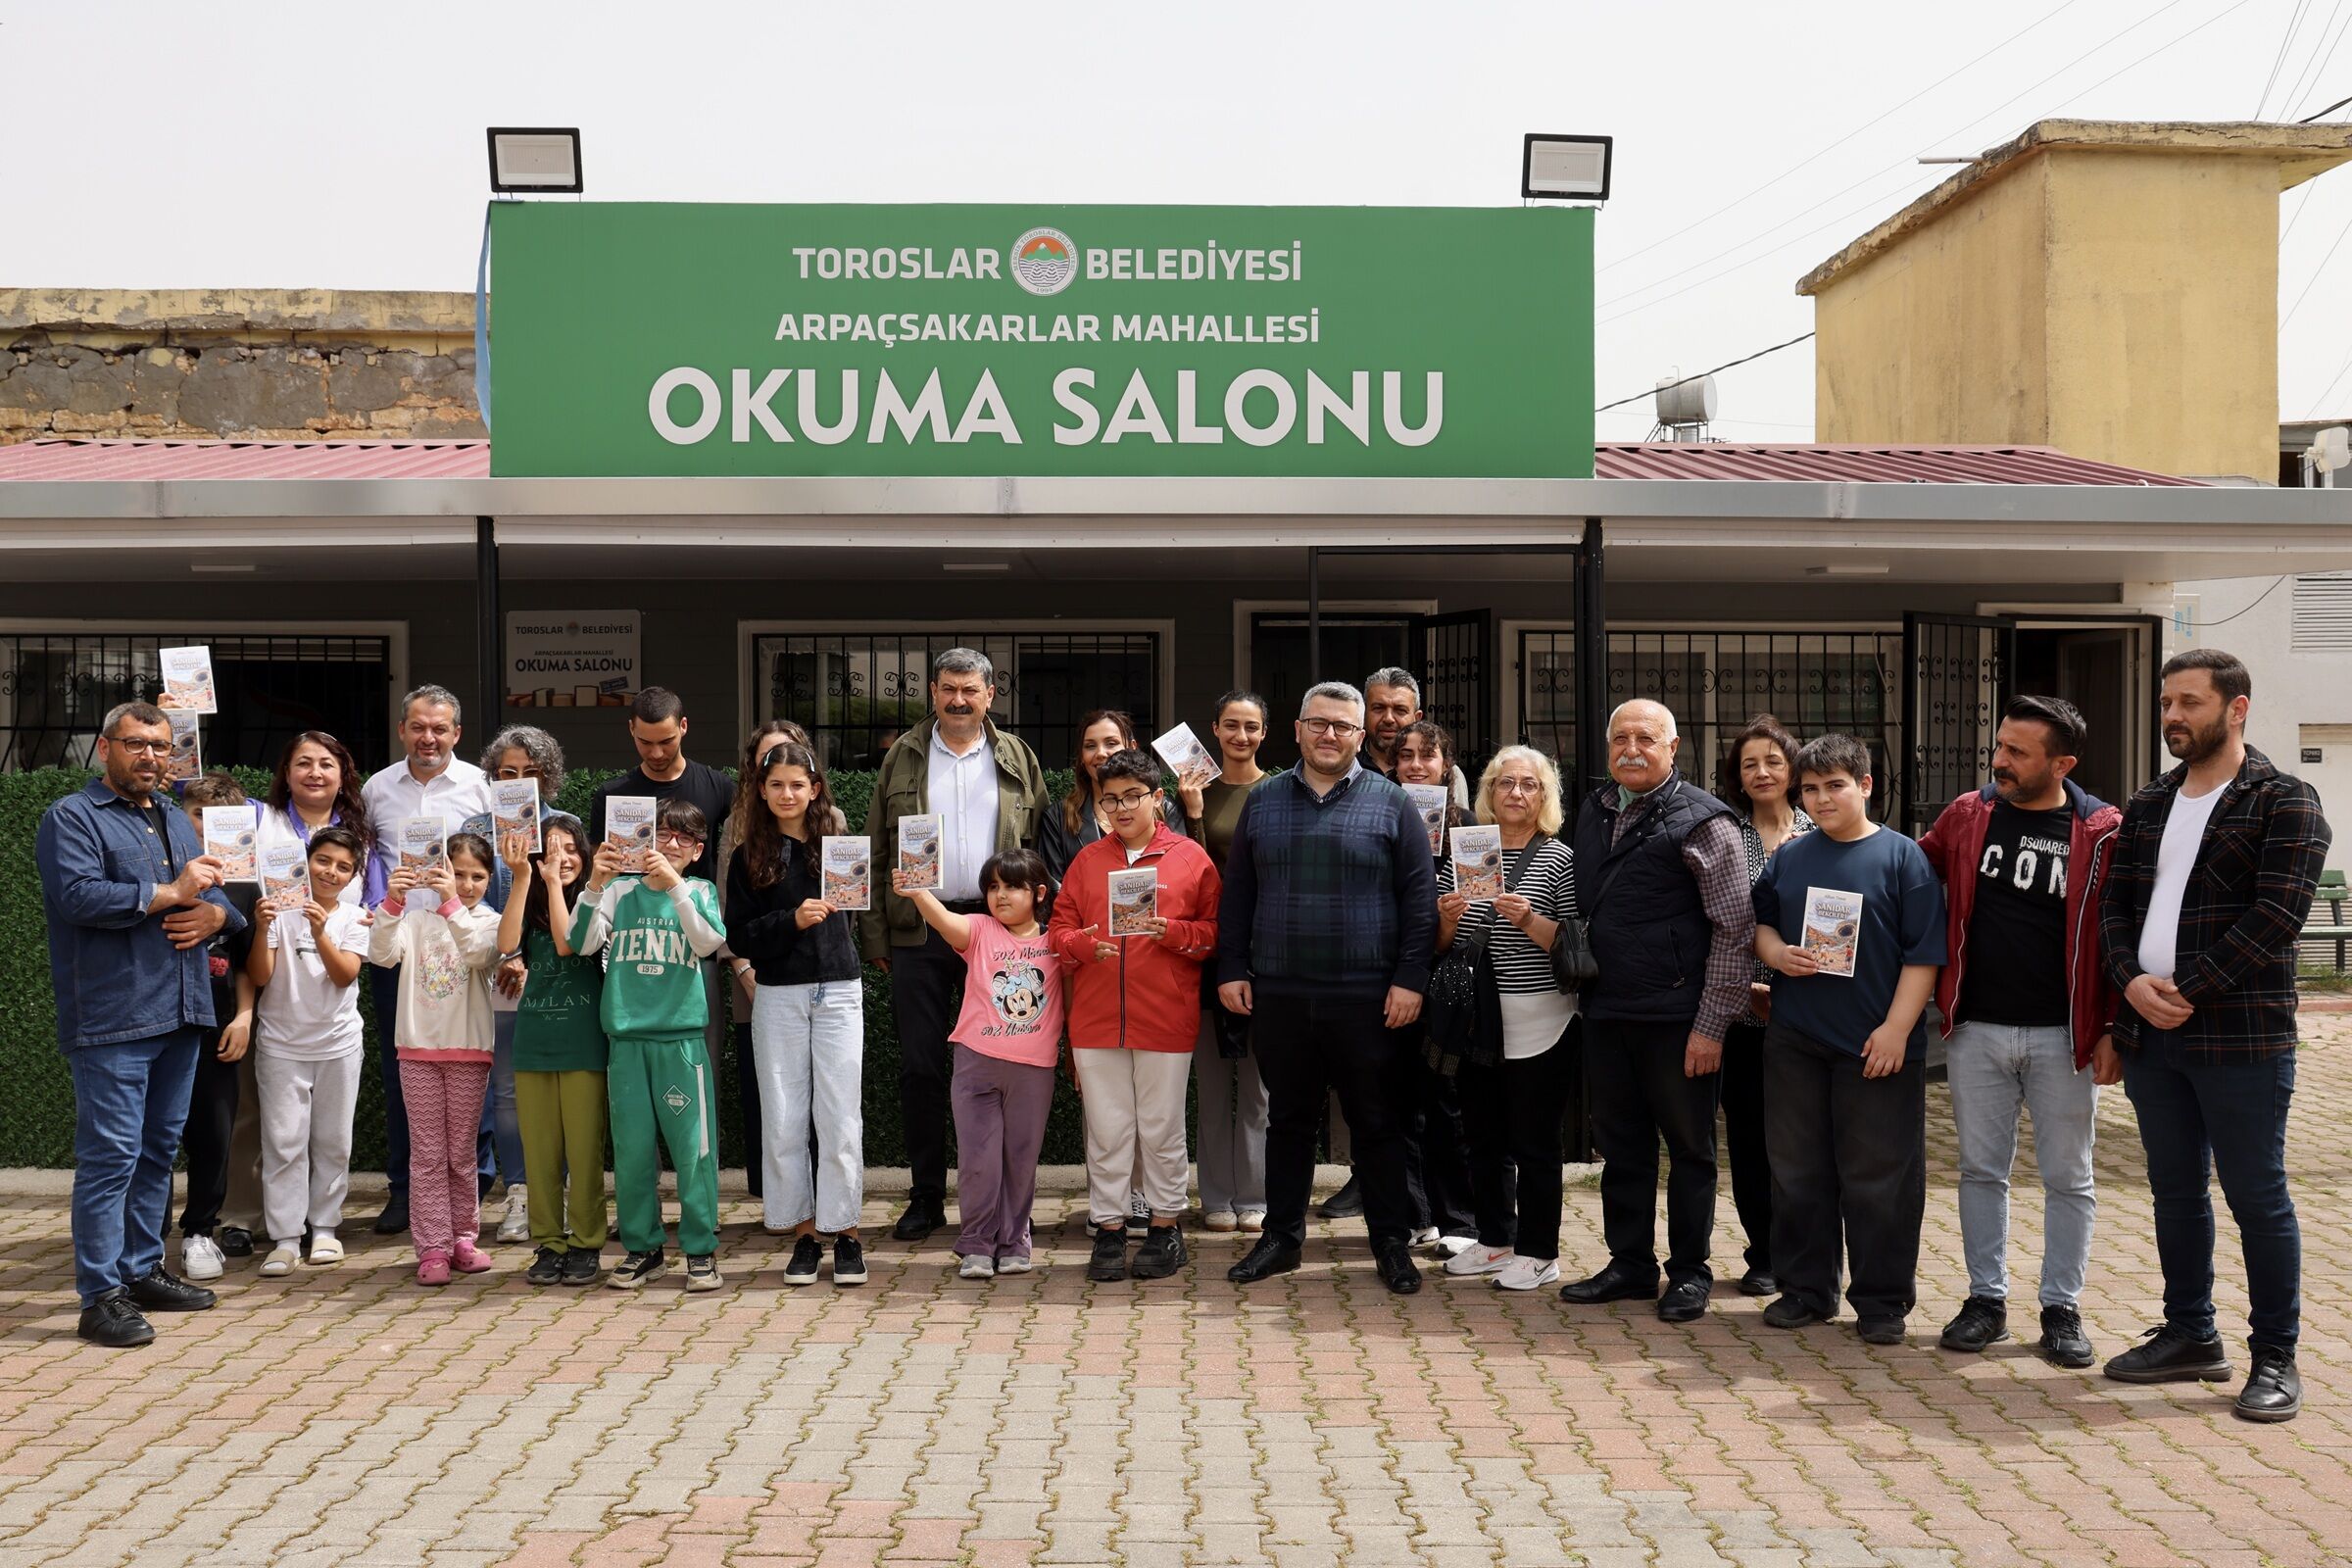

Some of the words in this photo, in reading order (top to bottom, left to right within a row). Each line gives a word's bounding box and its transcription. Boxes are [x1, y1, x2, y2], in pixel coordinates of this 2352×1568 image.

[792, 248, 1002, 279] TOROSLAR
[1087, 240, 1300, 281] BELEDİYESİ
[775, 314, 1102, 348] ARPAÇSAKARLAR
[1113, 308, 1319, 343] MAHALLESİ
[648, 367, 1023, 445] OKUMA
[1052, 367, 1444, 447] SALONU
[582, 623, 633, 634] BELEDİYESİ
[515, 659, 570, 672] OKUMA
[574, 659, 633, 671] SALONU
[637, 917, 674, 926] AUSTRIA
